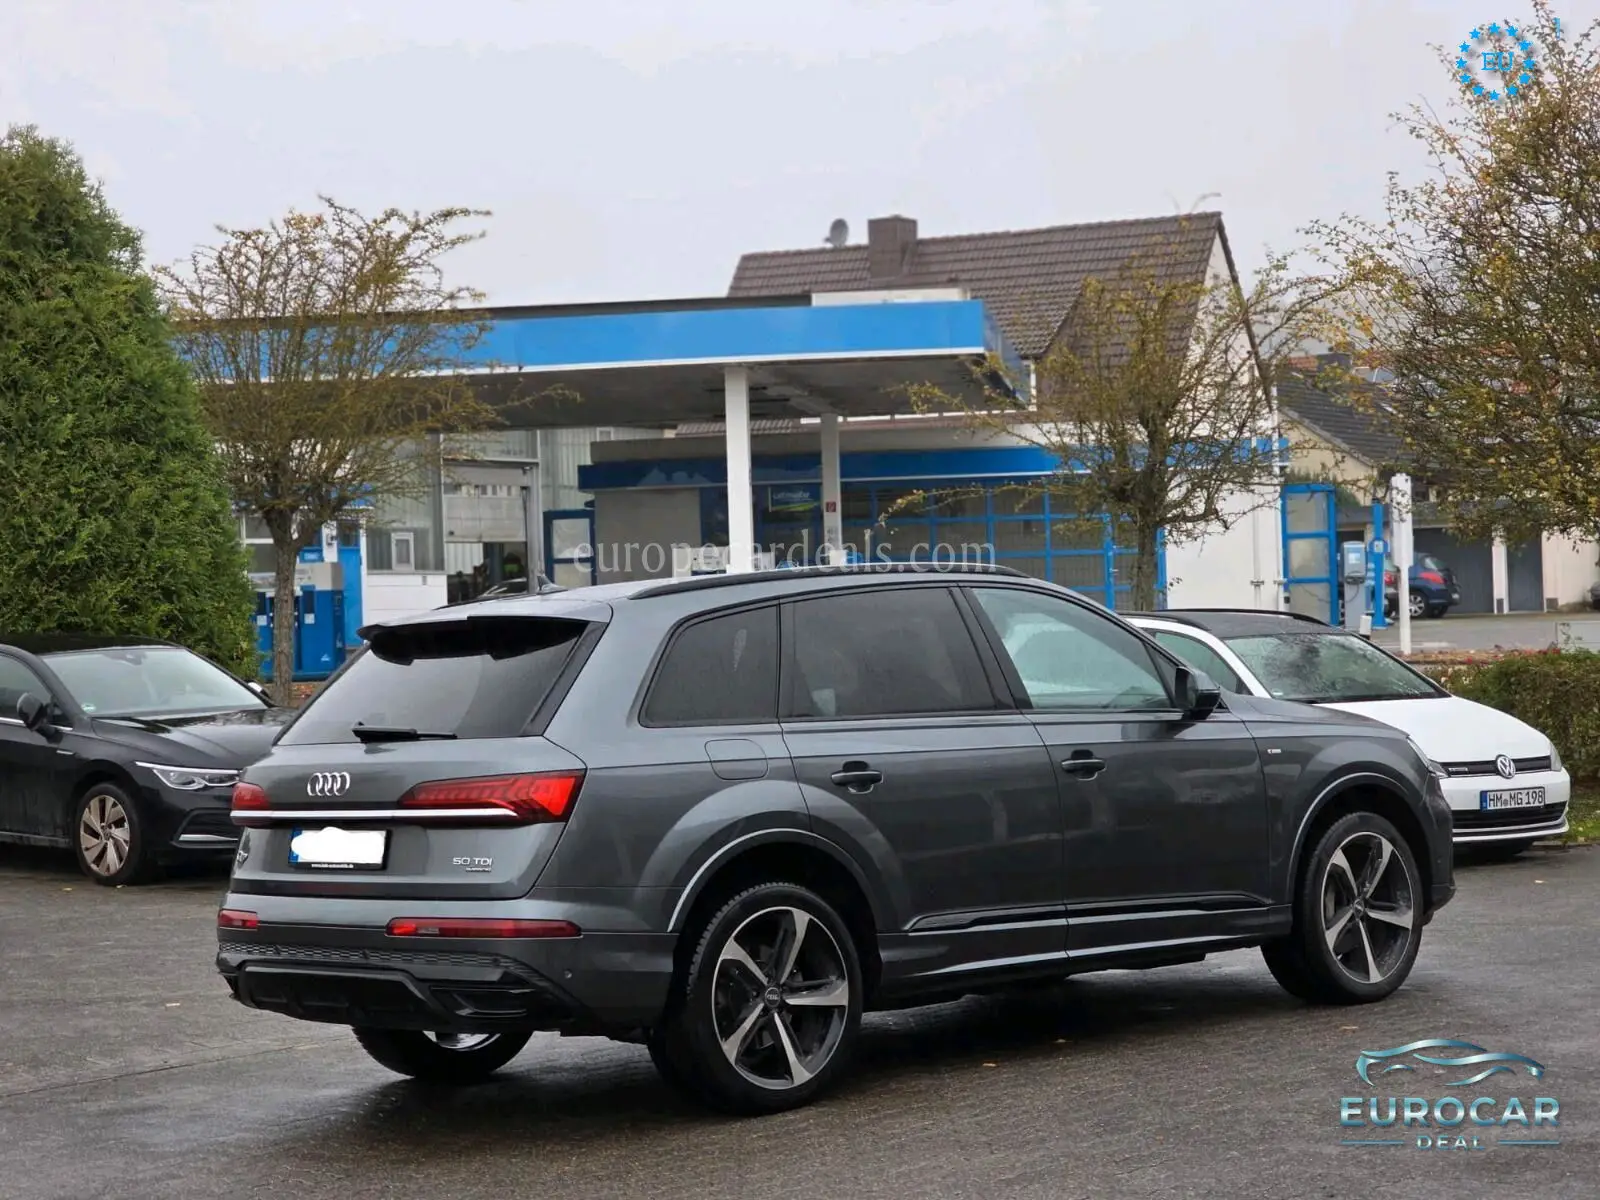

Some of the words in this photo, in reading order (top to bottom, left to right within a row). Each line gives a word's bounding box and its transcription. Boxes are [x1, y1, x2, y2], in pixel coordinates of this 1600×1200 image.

[1488, 792, 1503, 808] HM
[1509, 791, 1523, 806] MG
[1525, 790, 1544, 805] 198
[452, 857, 471, 865] 50
[472, 857, 493, 866] TDI
